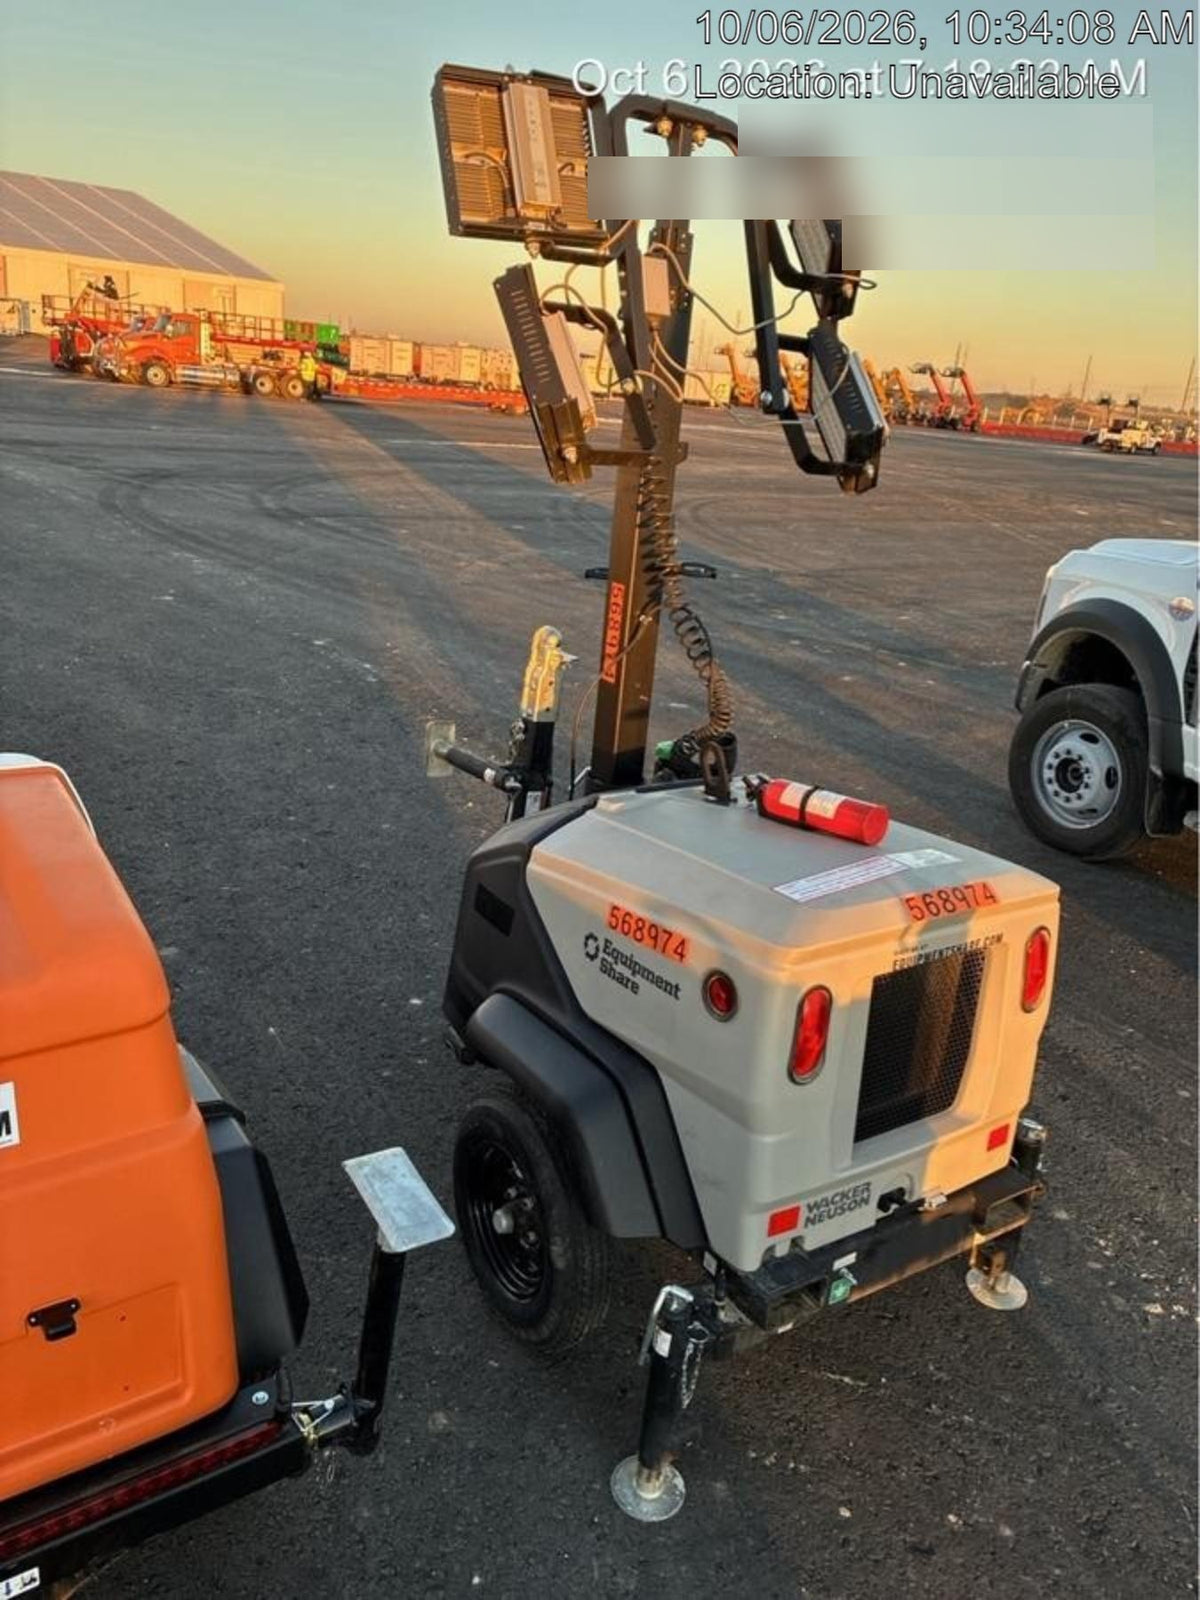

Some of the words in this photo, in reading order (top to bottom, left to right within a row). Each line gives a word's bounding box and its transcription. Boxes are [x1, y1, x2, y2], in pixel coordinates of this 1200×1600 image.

[904, 882, 996, 921] 568974
[608, 905, 686, 963] 568974
[599, 957, 640, 995] Share
[602, 938, 681, 1001] Equipment
[804, 1196, 871, 1229] NEUSON
[806, 1181, 872, 1213] WACKER
